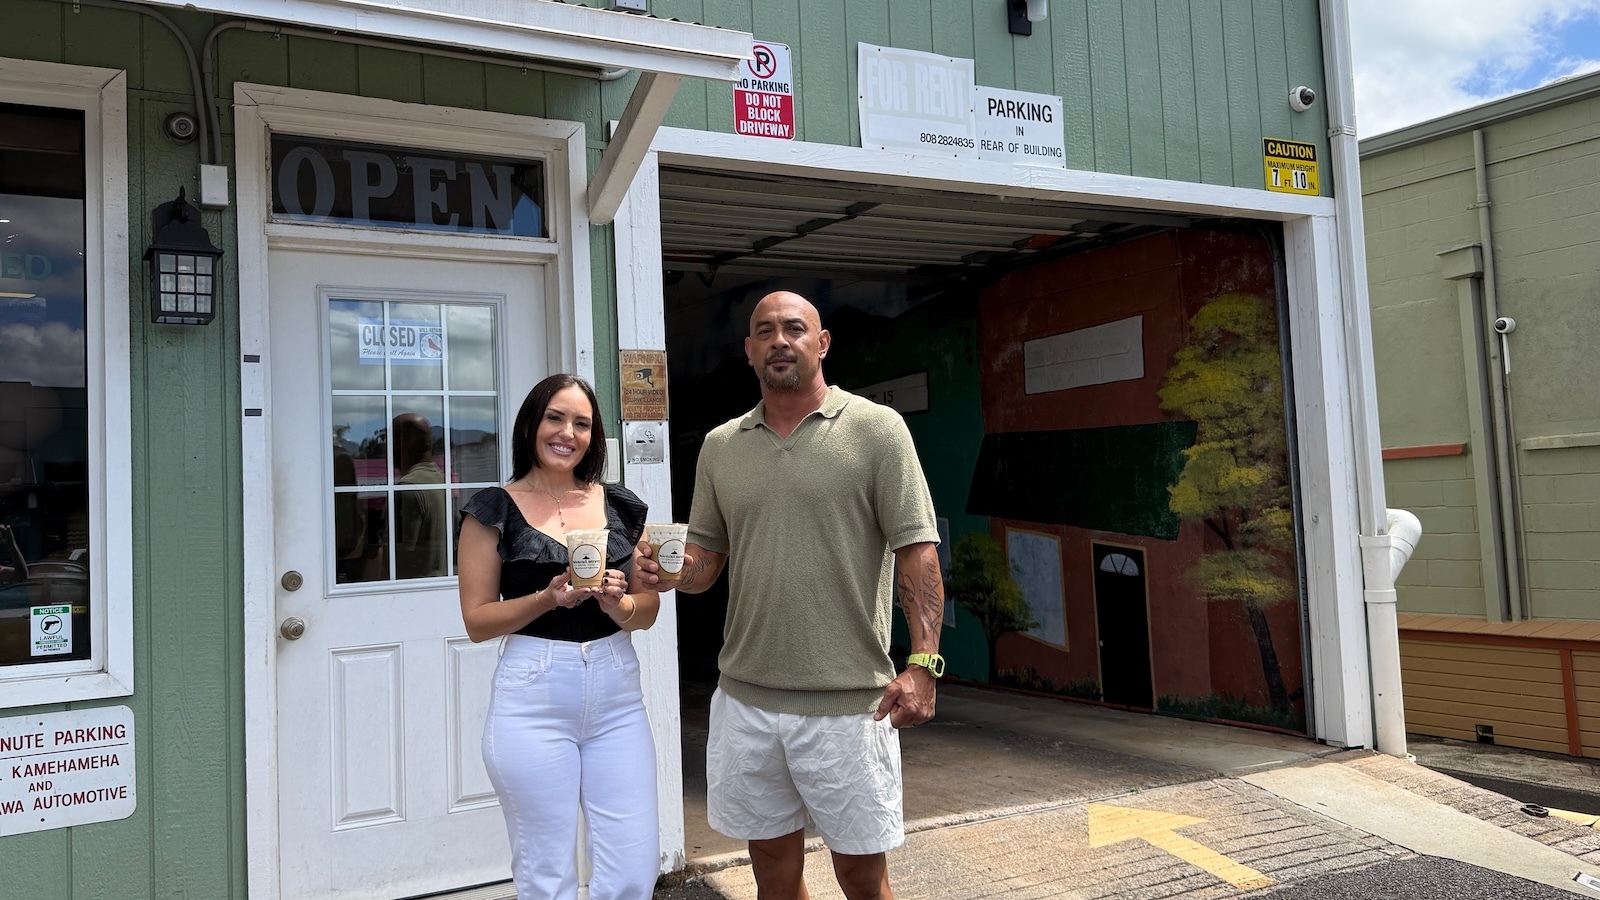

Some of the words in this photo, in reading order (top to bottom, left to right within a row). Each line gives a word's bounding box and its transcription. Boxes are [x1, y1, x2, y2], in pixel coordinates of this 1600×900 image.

[751, 79, 790, 93] PARKING
[866, 56, 908, 112] FOR
[914, 62, 966, 119] RENT
[745, 92, 760, 106] DO
[762, 94, 782, 108] NOT
[747, 106, 781, 122] BLOCK
[987, 97, 1053, 123] PARKING
[740, 120, 790, 137] DRIVEWAY
[1015, 126, 1024, 136] IN
[980, 139, 1004, 152] REAR
[1008, 142, 1020, 153] OF
[1024, 144, 1063, 158] BUILDING
[1267, 141, 1313, 159] CAUTION
[1267, 160, 1296, 170] MAXIMUM
[1296, 164, 1316, 173] HEIGHT
[1272, 168, 1279, 186] 7
[1294, 171, 1307, 189] 10
[277, 146, 515, 236] OPEN
[397, 349, 416, 357] Again
[54, 724, 126, 746] PARKING
[12, 753, 120, 779] KAMEHAMEHA
[28, 780, 53, 793] AND
[33, 785, 127, 811] AUTOMOTIVE
